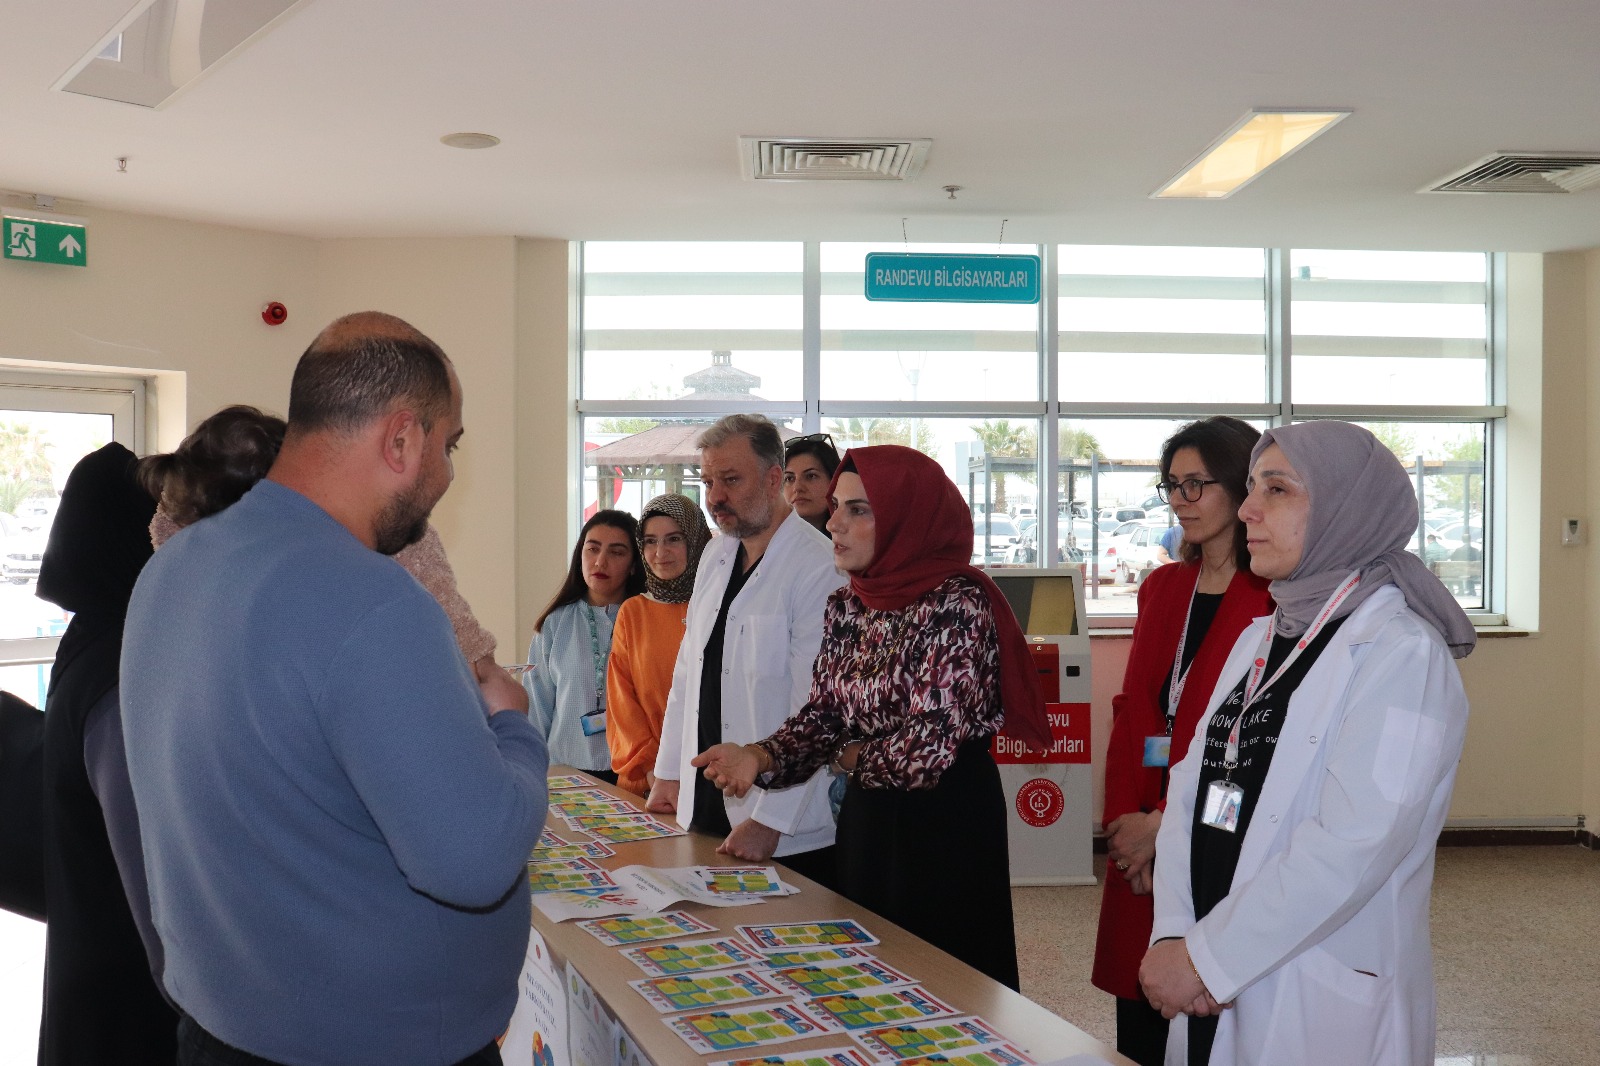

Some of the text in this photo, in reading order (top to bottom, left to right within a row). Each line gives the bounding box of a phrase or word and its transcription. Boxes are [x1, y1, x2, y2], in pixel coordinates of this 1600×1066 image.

[875, 265, 1028, 288] RANDEVU BİLGİSAYARLARI
[1265, 736, 1278, 744] ow
